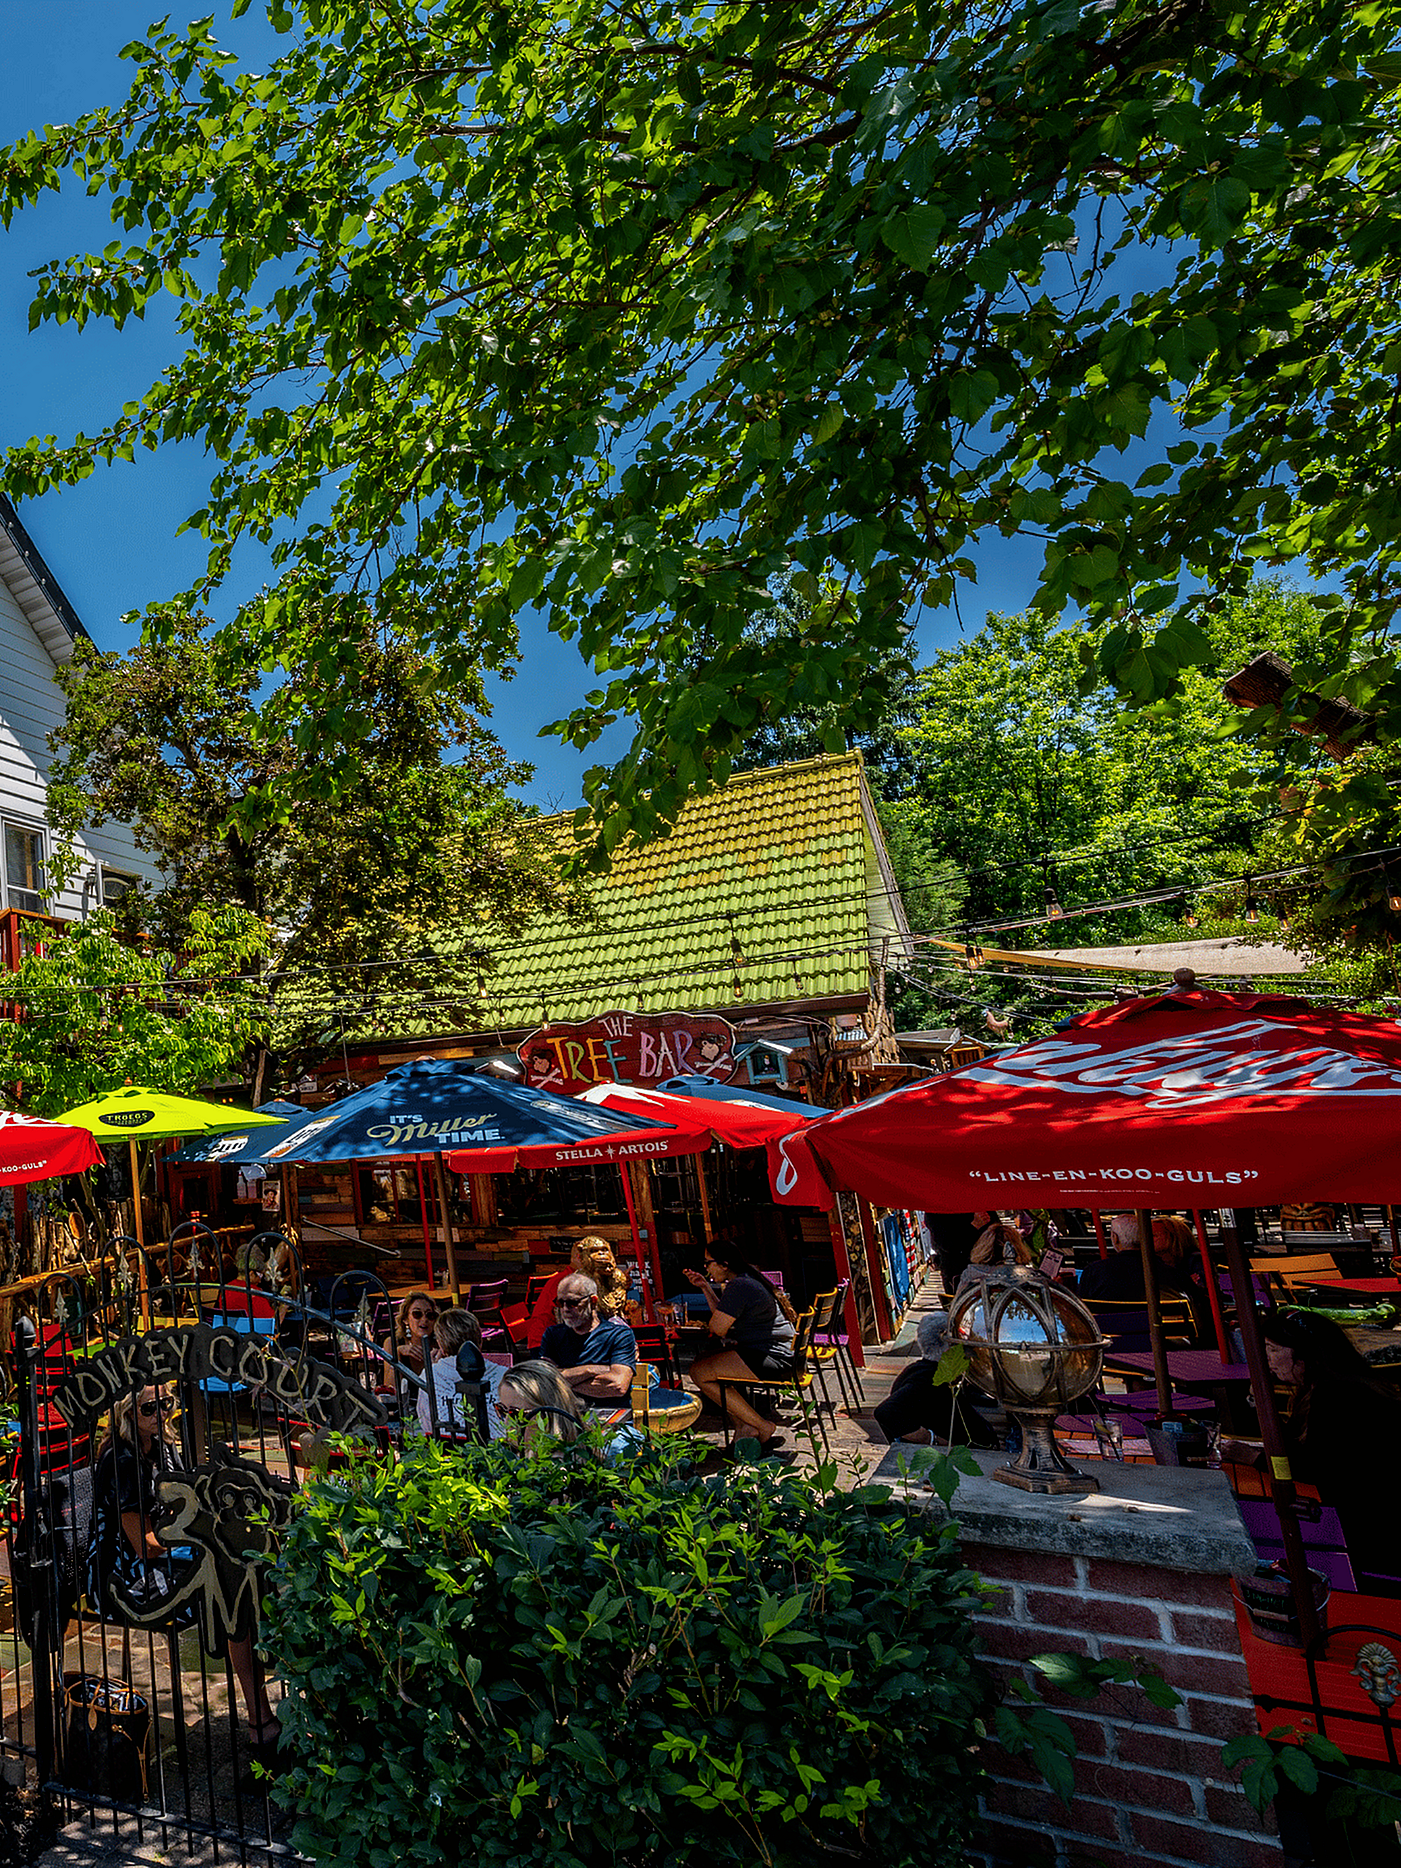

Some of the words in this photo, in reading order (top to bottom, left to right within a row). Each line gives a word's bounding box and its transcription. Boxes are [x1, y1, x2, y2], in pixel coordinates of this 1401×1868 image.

[599, 1016, 634, 1038] THE
[546, 1036, 633, 1084] TREE
[638, 1029, 696, 1078] BAR
[366, 1113, 497, 1147] Miller
[389, 1114, 423, 1124] IT'S
[555, 1148, 603, 1161] STELLA
[618, 1141, 668, 1155] ARTOIS
[54, 1334, 188, 1427] MONKEY
[209, 1335, 378, 1431] COURT
